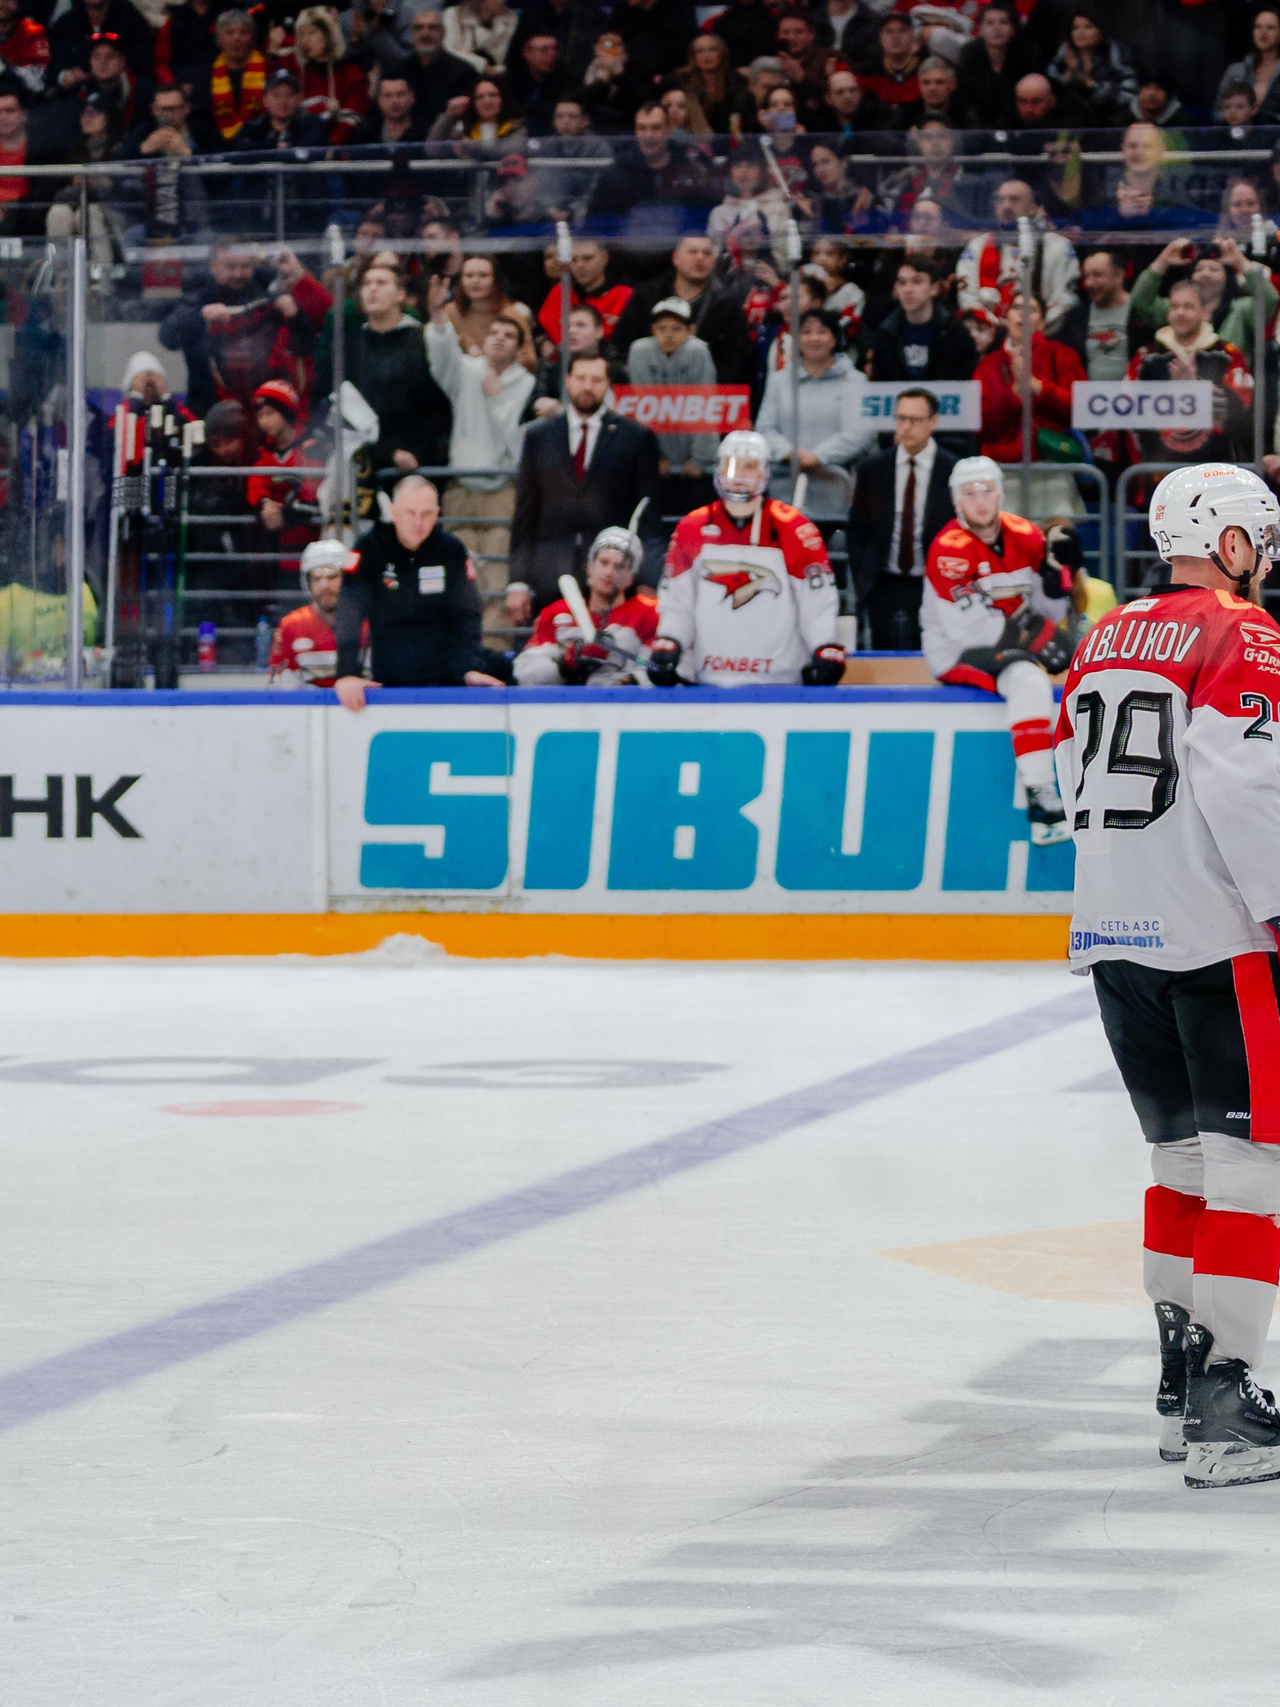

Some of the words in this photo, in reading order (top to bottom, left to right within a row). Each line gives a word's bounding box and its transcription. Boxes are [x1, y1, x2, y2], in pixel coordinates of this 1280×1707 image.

[617, 395, 749, 423] FONBET
[861, 394, 961, 417] SIR
[1087, 393, 1198, 417] согаз
[703, 655, 774, 673] FONBET
[1075, 690, 1179, 831] 29
[359, 731, 1074, 891] SIBUR
[1101, 921, 1129, 931] СЕТЬ
[1133, 921, 1160, 931] АЗС
[1226, 1111, 1251, 1120] BAU
